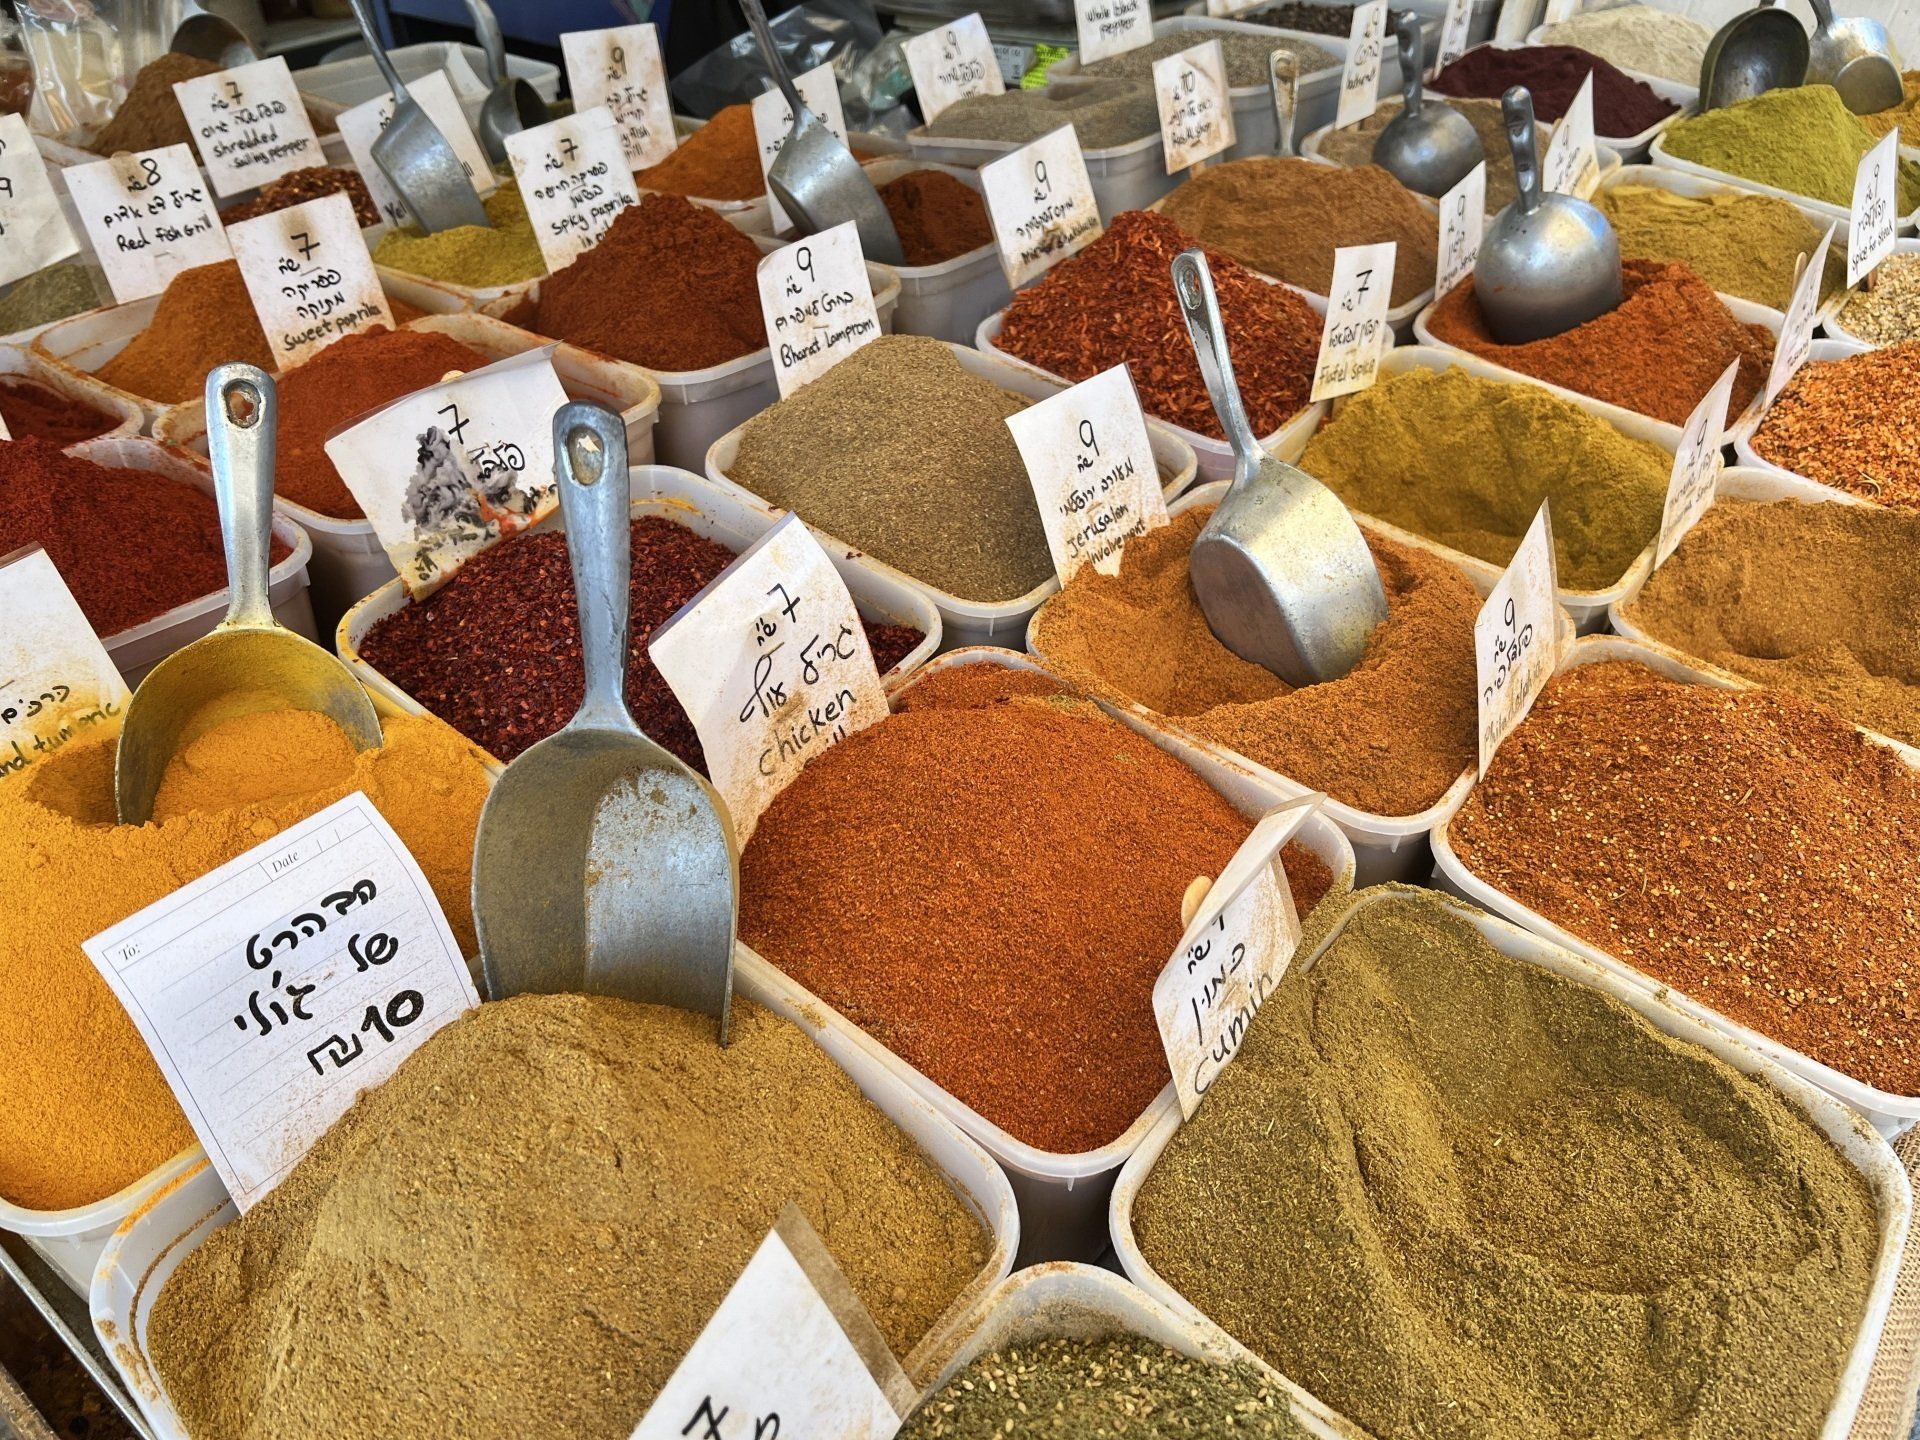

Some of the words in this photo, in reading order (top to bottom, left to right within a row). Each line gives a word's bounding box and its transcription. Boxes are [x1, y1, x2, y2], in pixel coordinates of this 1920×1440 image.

[610, 46, 628, 75] 9
[225, 81, 243, 105] 7
[560, 137, 579, 162] 7
[140, 157, 161, 186] 8
[1033, 160, 1052, 193] 9
[1873, 163, 1880, 199] 9
[116, 226, 151, 252] Red
[290, 232, 321, 262] 7
[278, 257, 301, 275] ש"ח
[796, 246, 815, 283] 9
[281, 269, 342, 301] פפריקה
[1356, 269, 1373, 305] 7
[296, 291, 346, 320] מתוקה
[437, 403, 471, 445] 7
[1078, 419, 1100, 457] 9
[1696, 418, 1708, 459] 9
[766, 582, 801, 623] 7
[1503, 597, 1516, 634] 9
[757, 617, 777, 647] ש"ח
[799, 621, 857, 686] גריל
[739, 653, 788, 724] עוף
[270, 848, 300, 874] Date
[117, 940, 143, 963] To:
[347, 932, 400, 974] של
[1190, 941, 1247, 1047] כמון
